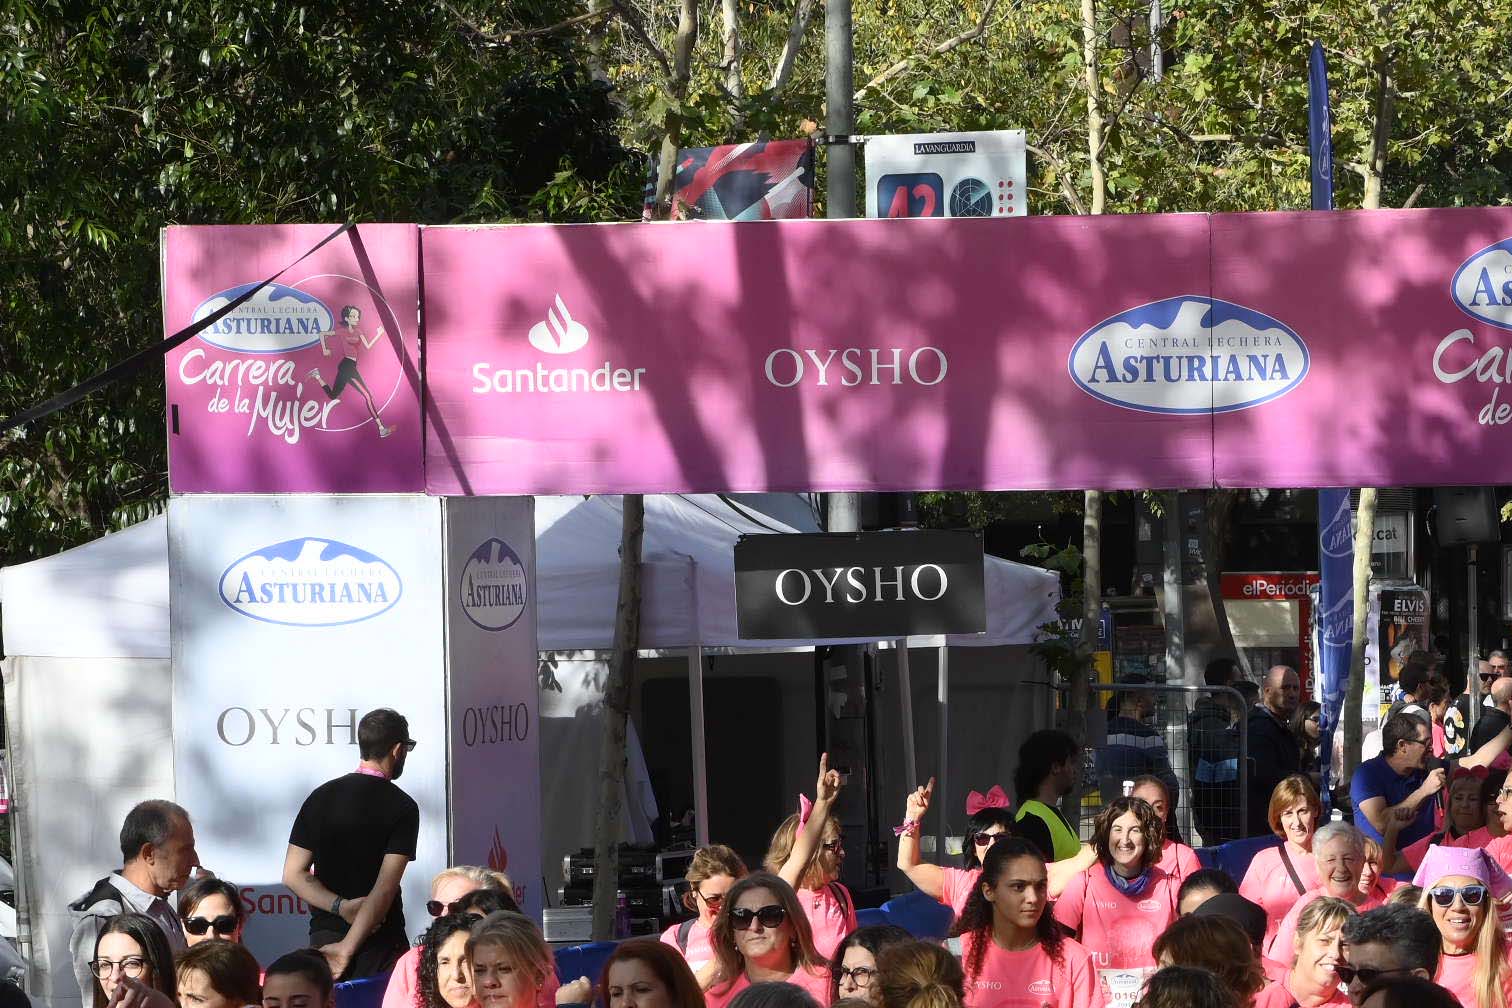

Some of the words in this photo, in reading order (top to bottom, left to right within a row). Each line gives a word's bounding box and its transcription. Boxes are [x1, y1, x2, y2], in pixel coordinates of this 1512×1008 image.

[230, 307, 268, 315] ENTRAL
[1124, 337, 1199, 349] CENTRAL
[1208, 335, 1283, 348] LECHERA
[179, 349, 296, 386] Carrera
[472, 361, 646, 394] Santander
[765, 346, 949, 389] OYSHO
[1088, 341, 1290, 383] ASTURIANA
[208, 388, 229, 413] de
[234, 388, 250, 413] la
[247, 382, 341, 444] Mujer
[1478, 386, 1512, 426] de
[233, 571, 389, 605] ASTURIANA
[465, 573, 524, 608] ASTURIANA
[774, 563, 949, 606] OYSHO
[1394, 599, 1424, 612] ELVIS
[216, 705, 360, 746] OYSH
[462, 702, 530, 748] OYSHO
[240, 887, 308, 915] Sant
[1092, 951, 1111, 967] TU
[974, 980, 1002, 991] YSHO
